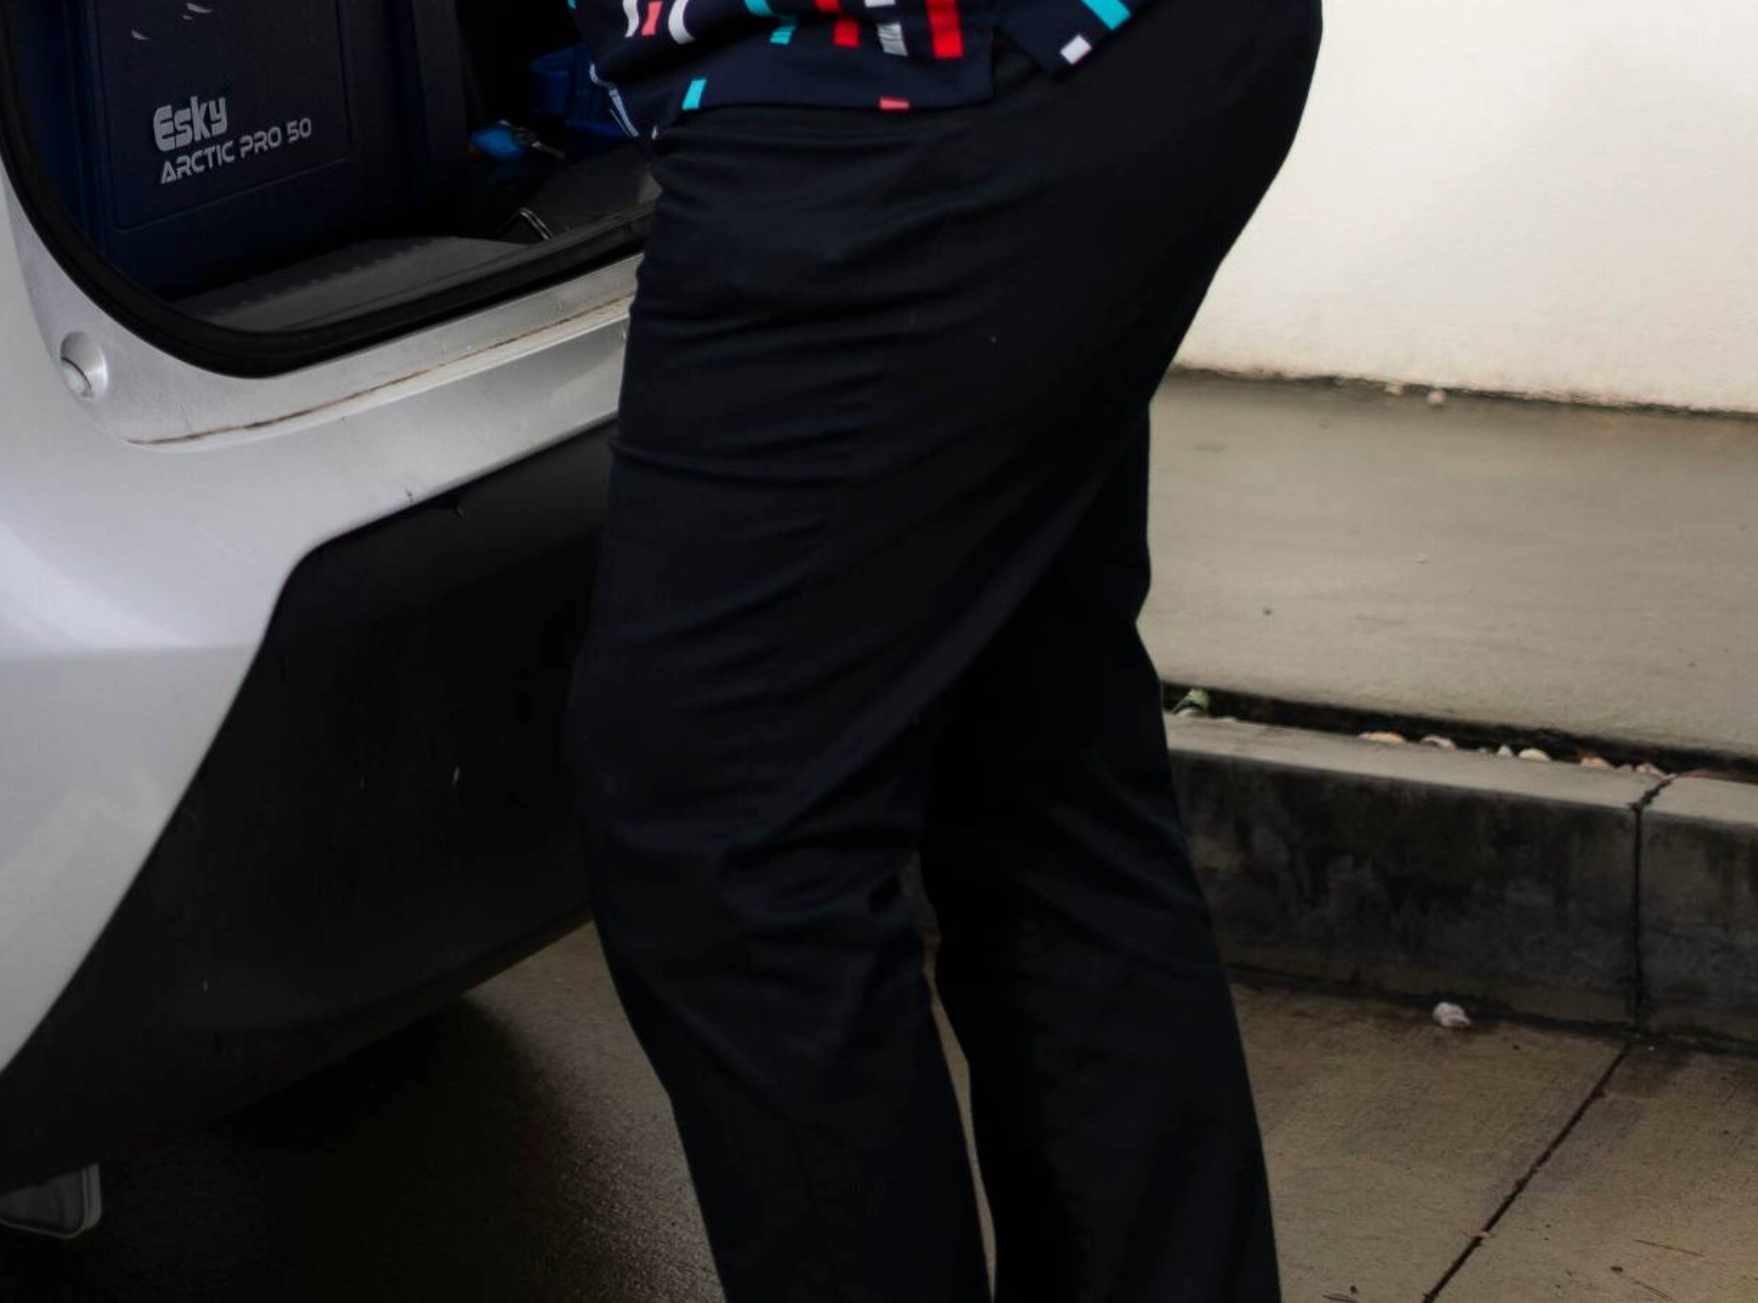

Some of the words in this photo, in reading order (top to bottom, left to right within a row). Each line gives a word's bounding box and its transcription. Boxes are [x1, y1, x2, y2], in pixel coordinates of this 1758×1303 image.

[153, 95, 228, 152] Esky
[160, 140, 235, 185] ARCTIC
[239, 126, 282, 159] PRO
[287, 117, 312, 143] 50
